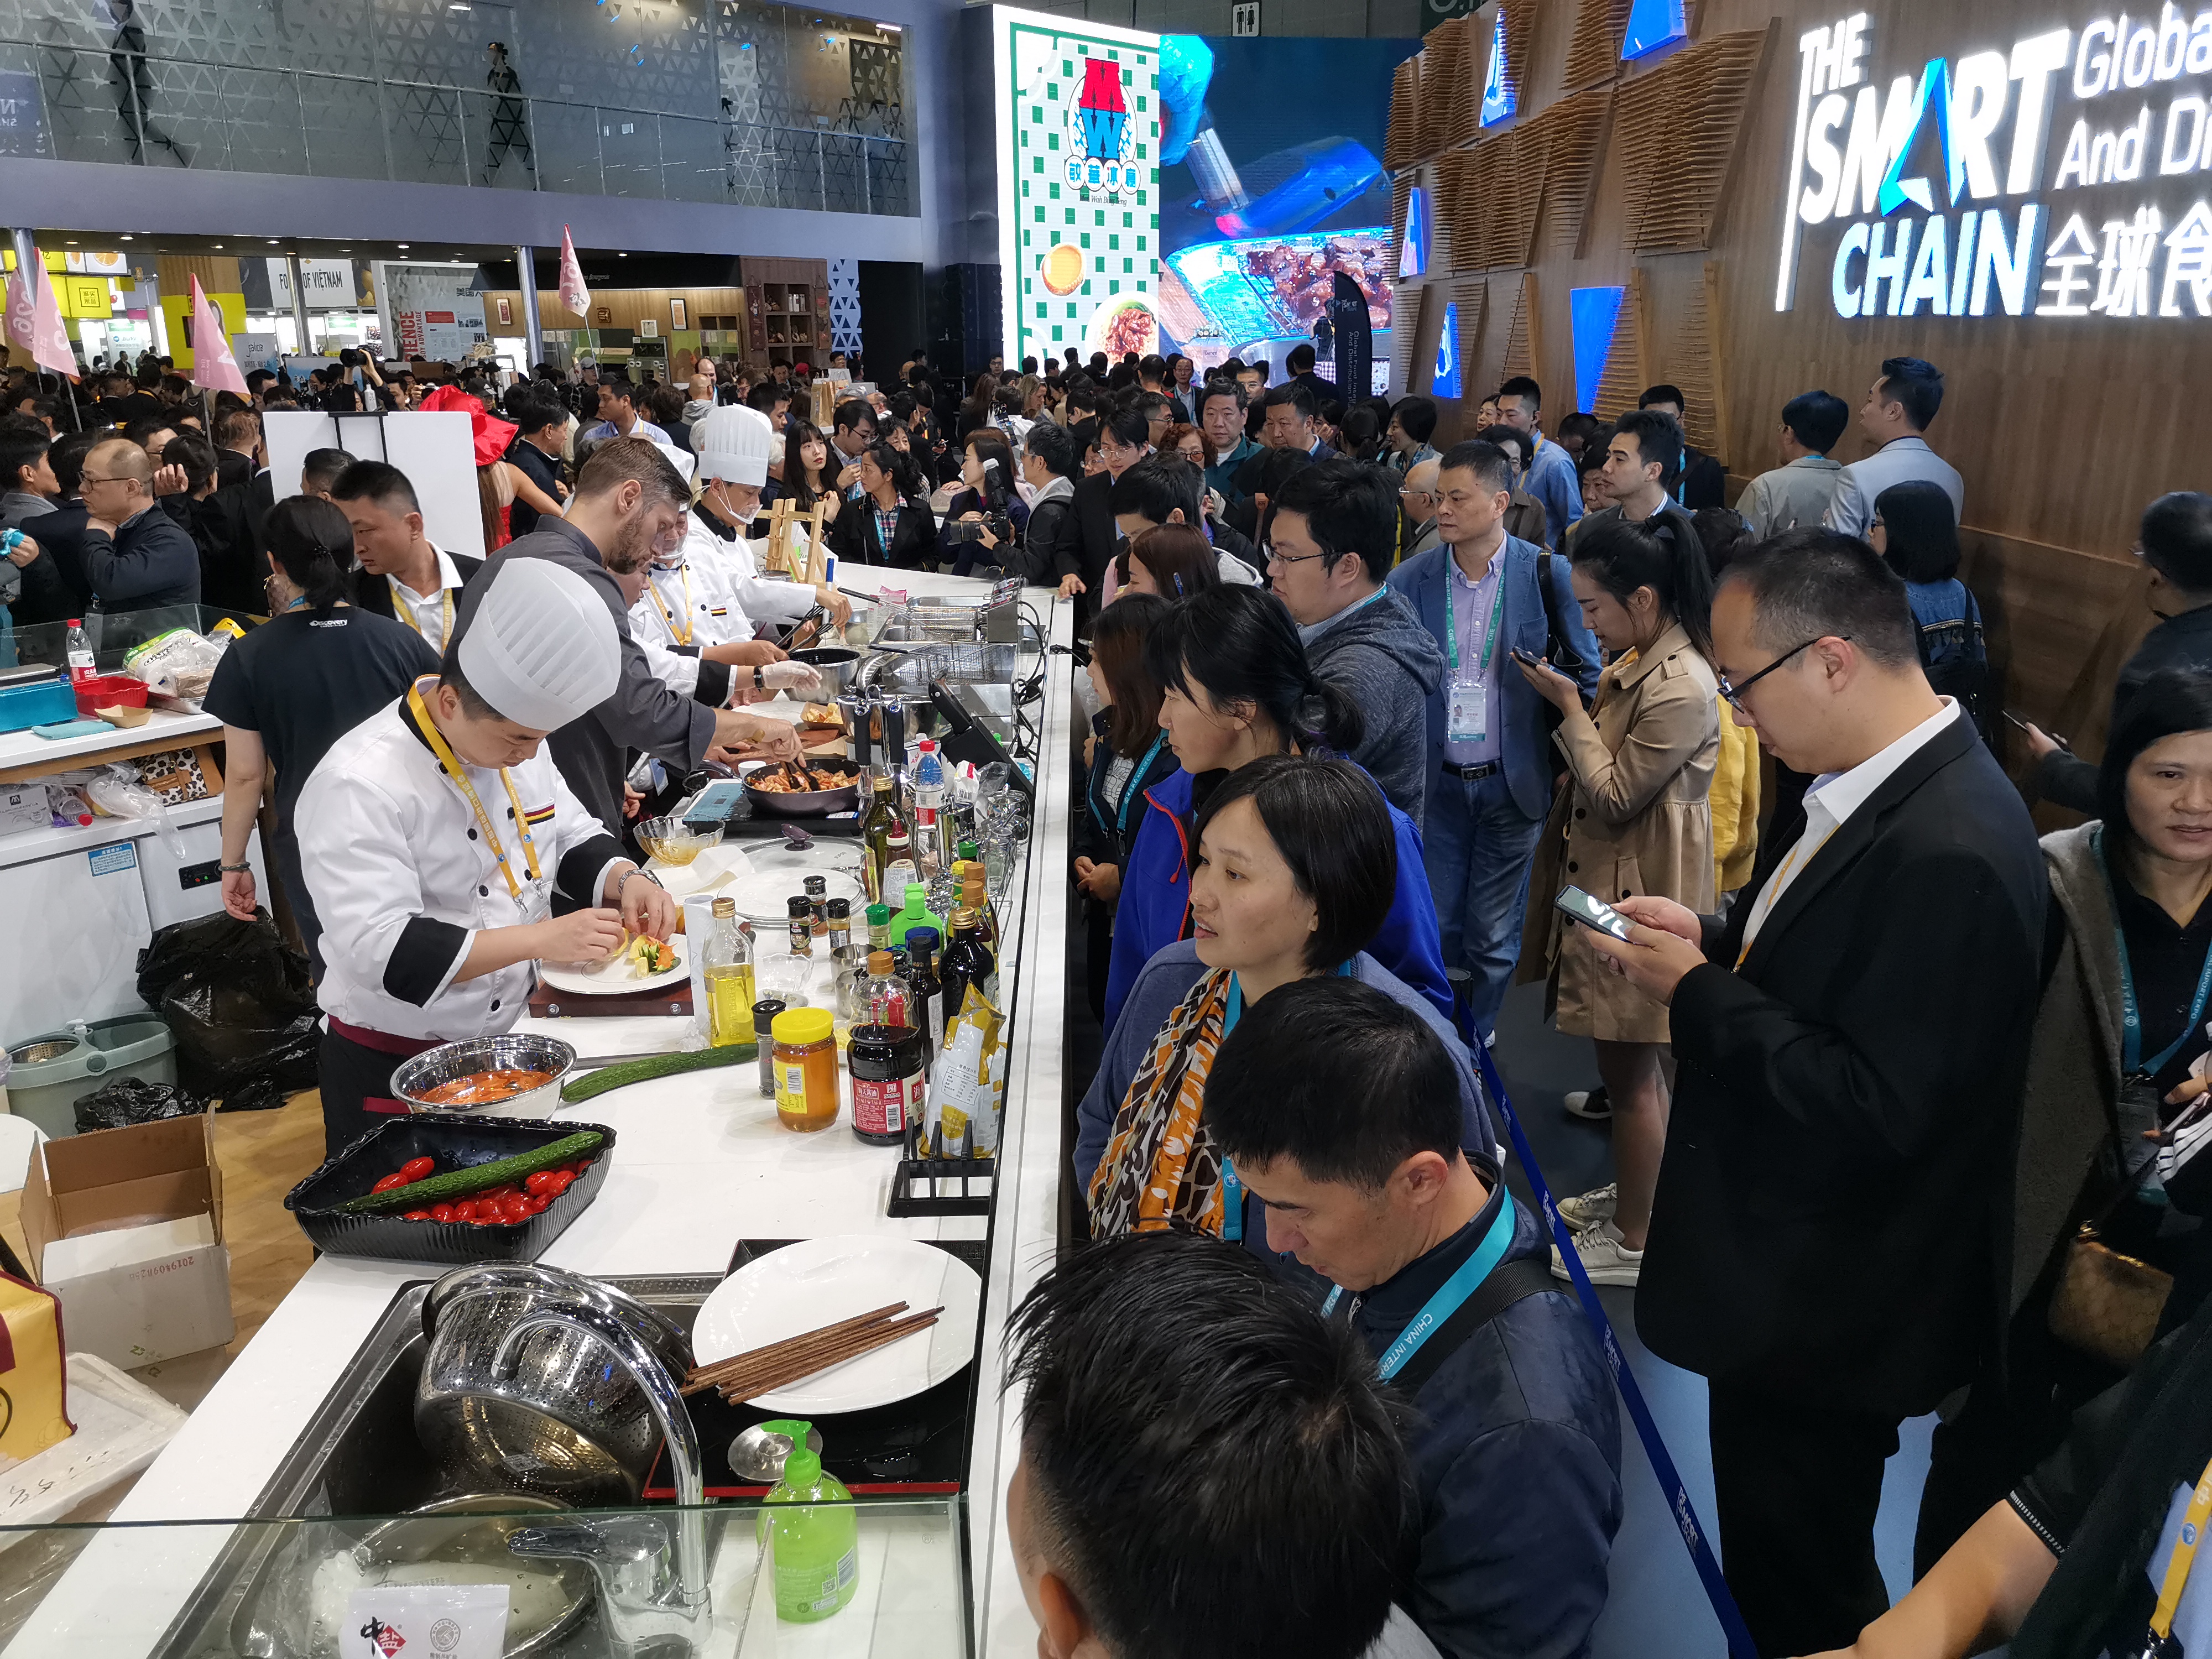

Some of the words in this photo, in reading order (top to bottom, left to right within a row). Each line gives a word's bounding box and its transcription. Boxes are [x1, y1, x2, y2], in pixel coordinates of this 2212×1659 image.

[1799, 28, 2070, 224] SMART
[2055, 107, 2150, 190] And
[302, 272, 311, 288] OF
[1832, 202, 2039, 319] CHAIN
[2035, 201, 2212, 319] 全球食
[415, 311, 425, 345] ADVANTAGE
[510, 788, 521, 811] IMPORT
[518, 811, 526, 828] EXPO
[1405, 1313, 1433, 1344] CHINA
[360, 1616, 403, 1657] 中盐
